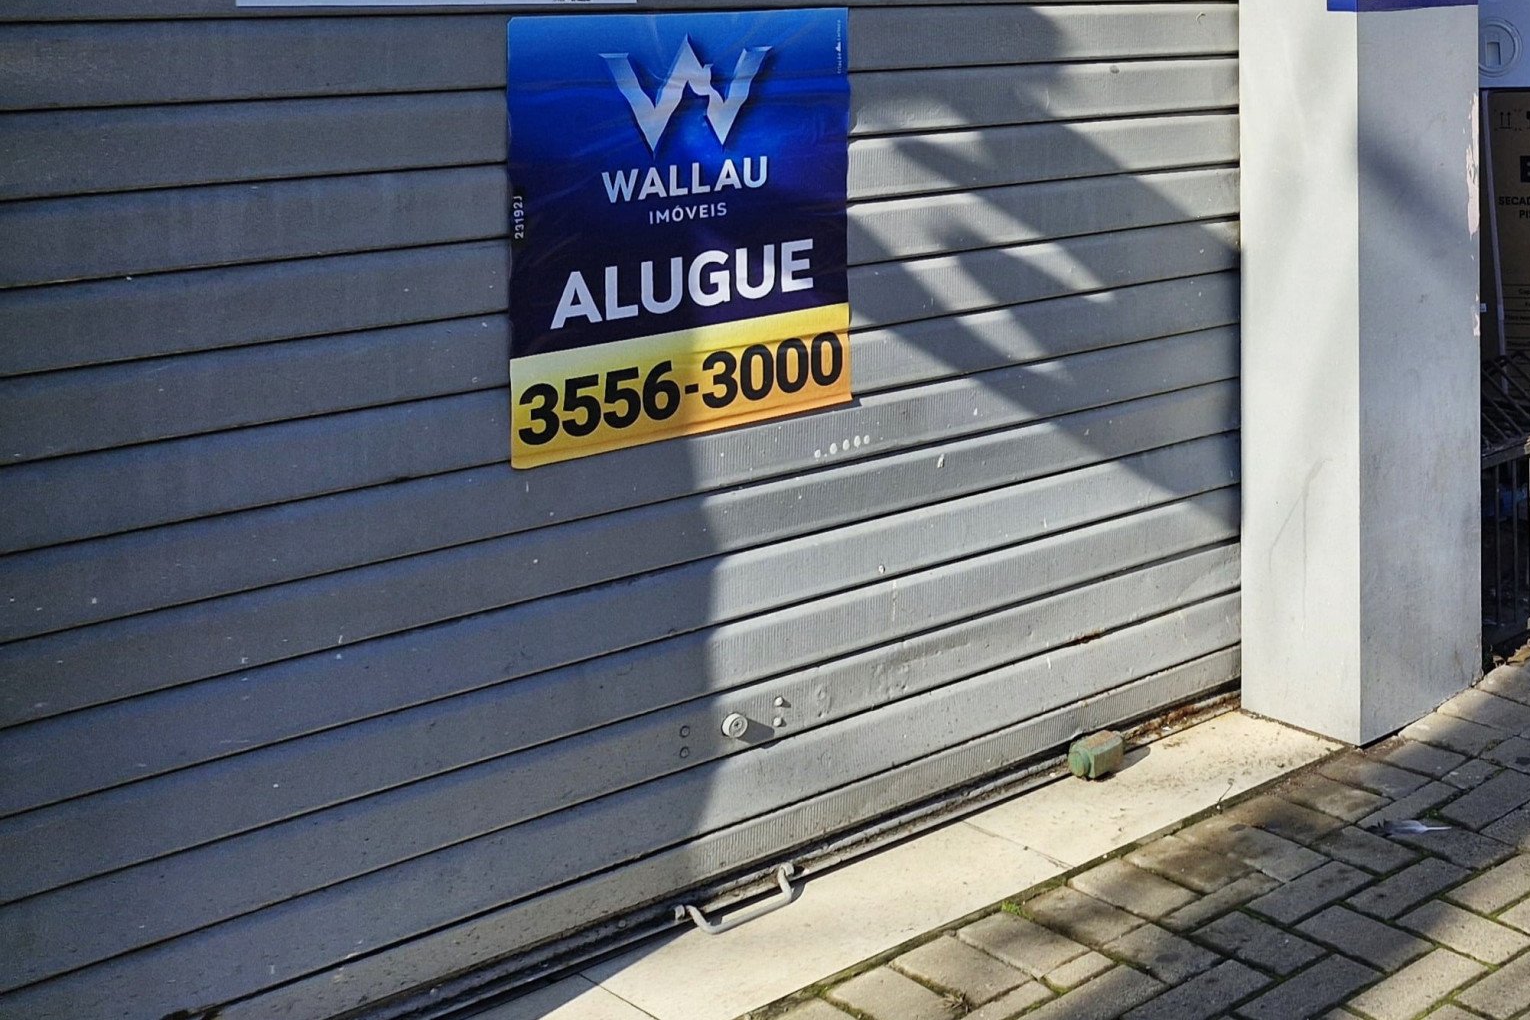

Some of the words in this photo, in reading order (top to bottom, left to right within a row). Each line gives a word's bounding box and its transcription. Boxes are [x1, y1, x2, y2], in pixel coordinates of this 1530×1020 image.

[601, 156, 768, 204] WALLAU
[514, 195, 524, 240] 23192J
[649, 201, 728, 225] IMÓVEIS
[550, 239, 814, 330] ALUGUE
[518, 331, 843, 446] 3556-3000
